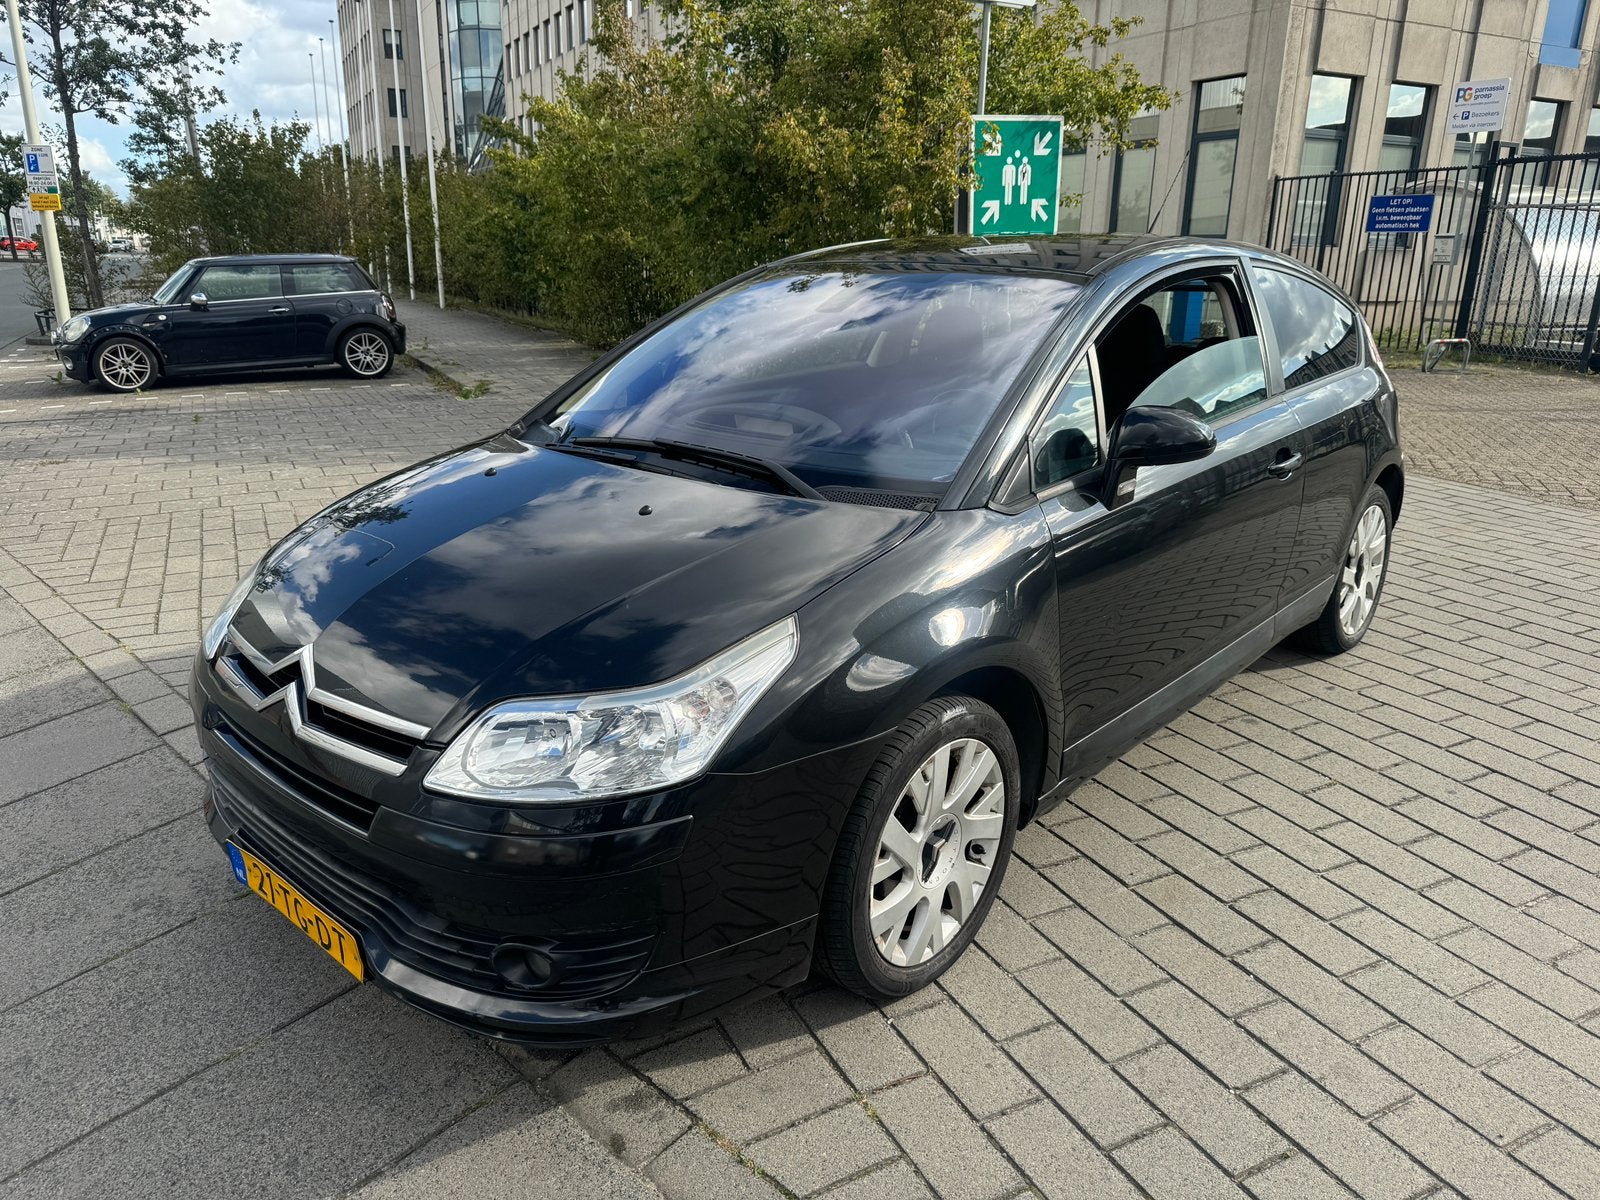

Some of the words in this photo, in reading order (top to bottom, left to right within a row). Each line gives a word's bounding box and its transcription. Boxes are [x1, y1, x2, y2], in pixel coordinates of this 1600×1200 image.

[1474, 84, 1504, 94] parnassia
[235, 866, 247, 881] NL
[252, 861, 346, 965] 21-TG-DT
